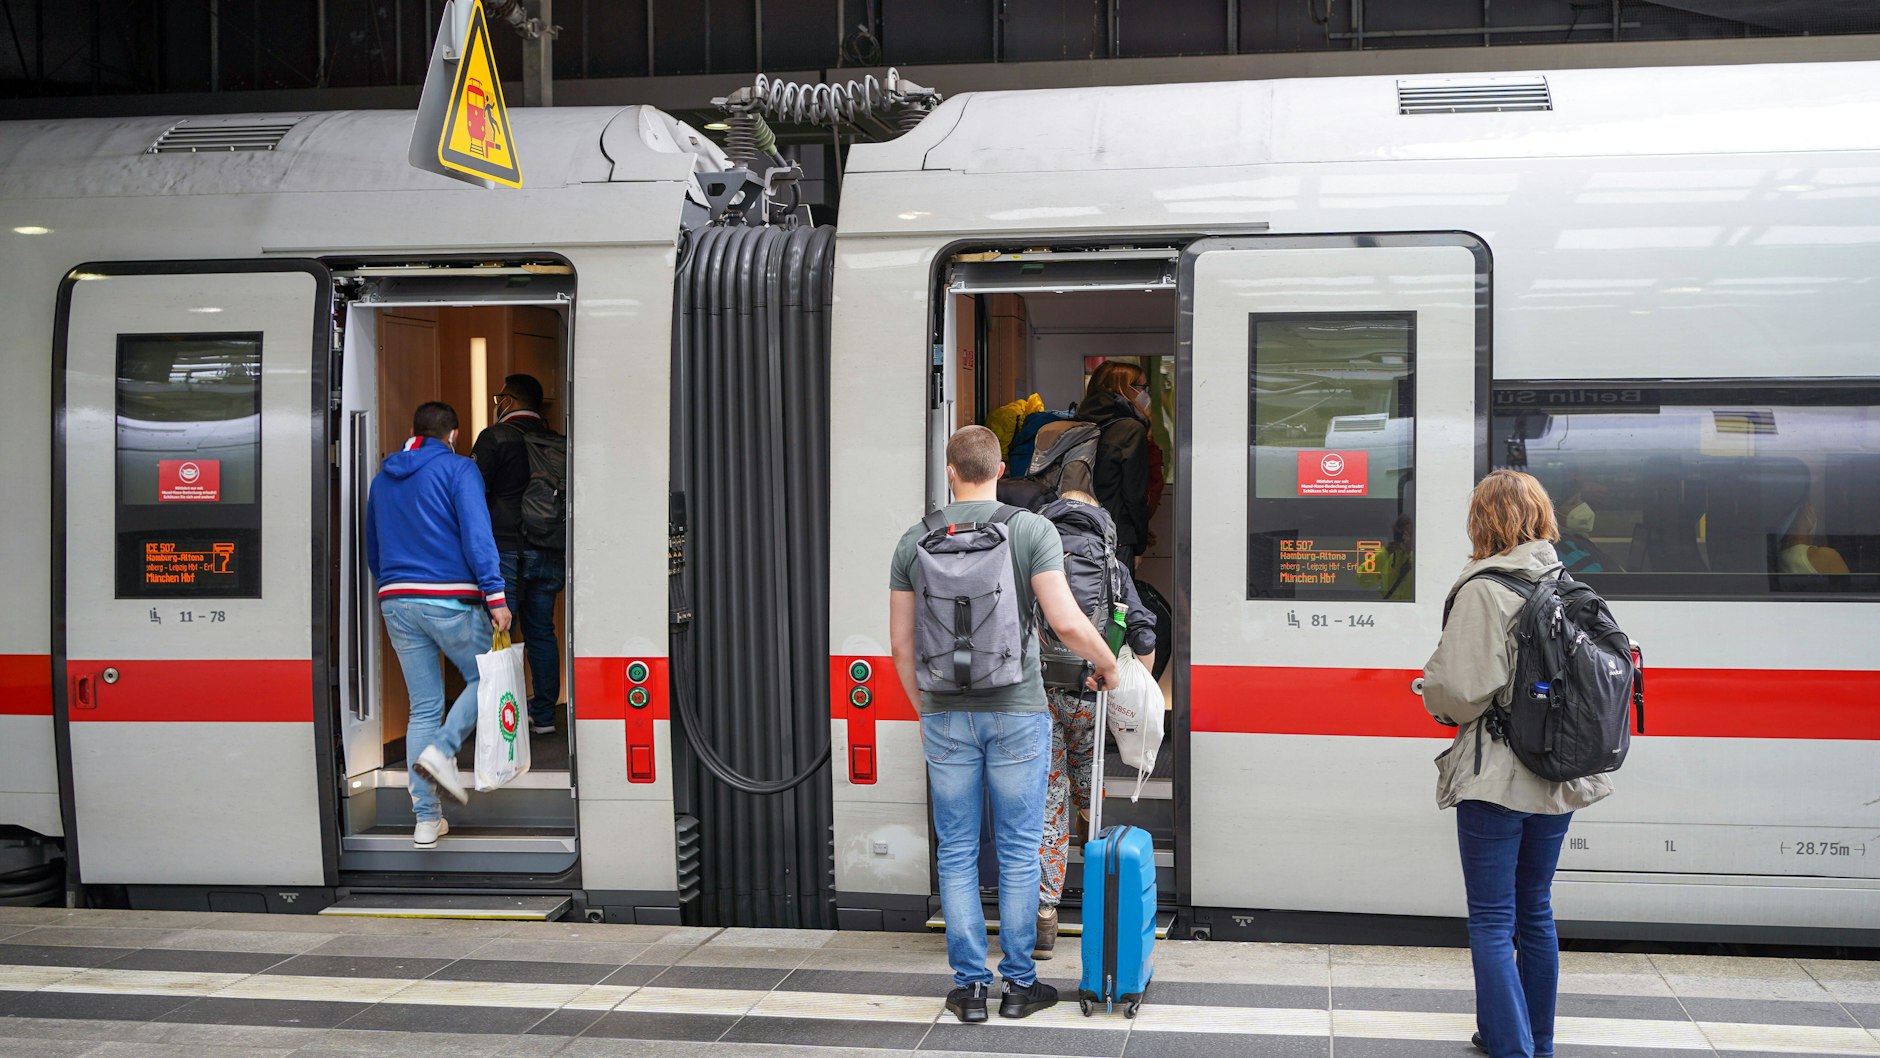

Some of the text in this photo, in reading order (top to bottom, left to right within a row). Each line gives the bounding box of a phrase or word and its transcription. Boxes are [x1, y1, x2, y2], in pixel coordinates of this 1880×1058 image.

[146, 543, 175, 552] ICE 507
[1280, 540, 1313, 550] ICE 507
[146, 554, 204, 562] Hamburg-Altona
[1280, 552, 1346, 561] Hamburg-Altona
[1364, 552, 1375, 572] 8
[169, 564, 187, 572] Leipzig
[188, 563, 198, 571] Hbf
[219, 553, 230, 572] 7
[1307, 562, 1328, 571] Leipzig
[1329, 562, 1340, 570] Hbf
[146, 573, 195, 582] München Hbf
[1280, 572, 1336, 583] München Hbf
[180, 611, 193, 622] 11
[210, 611, 226, 622] 78
[1311, 614, 1328, 627] 81
[1348, 615, 1375, 627] 144
[1570, 838, 1589, 850] HBL
[1665, 840, 1676, 851] 1L
[1796, 842, 1850, 856] 28.75m
